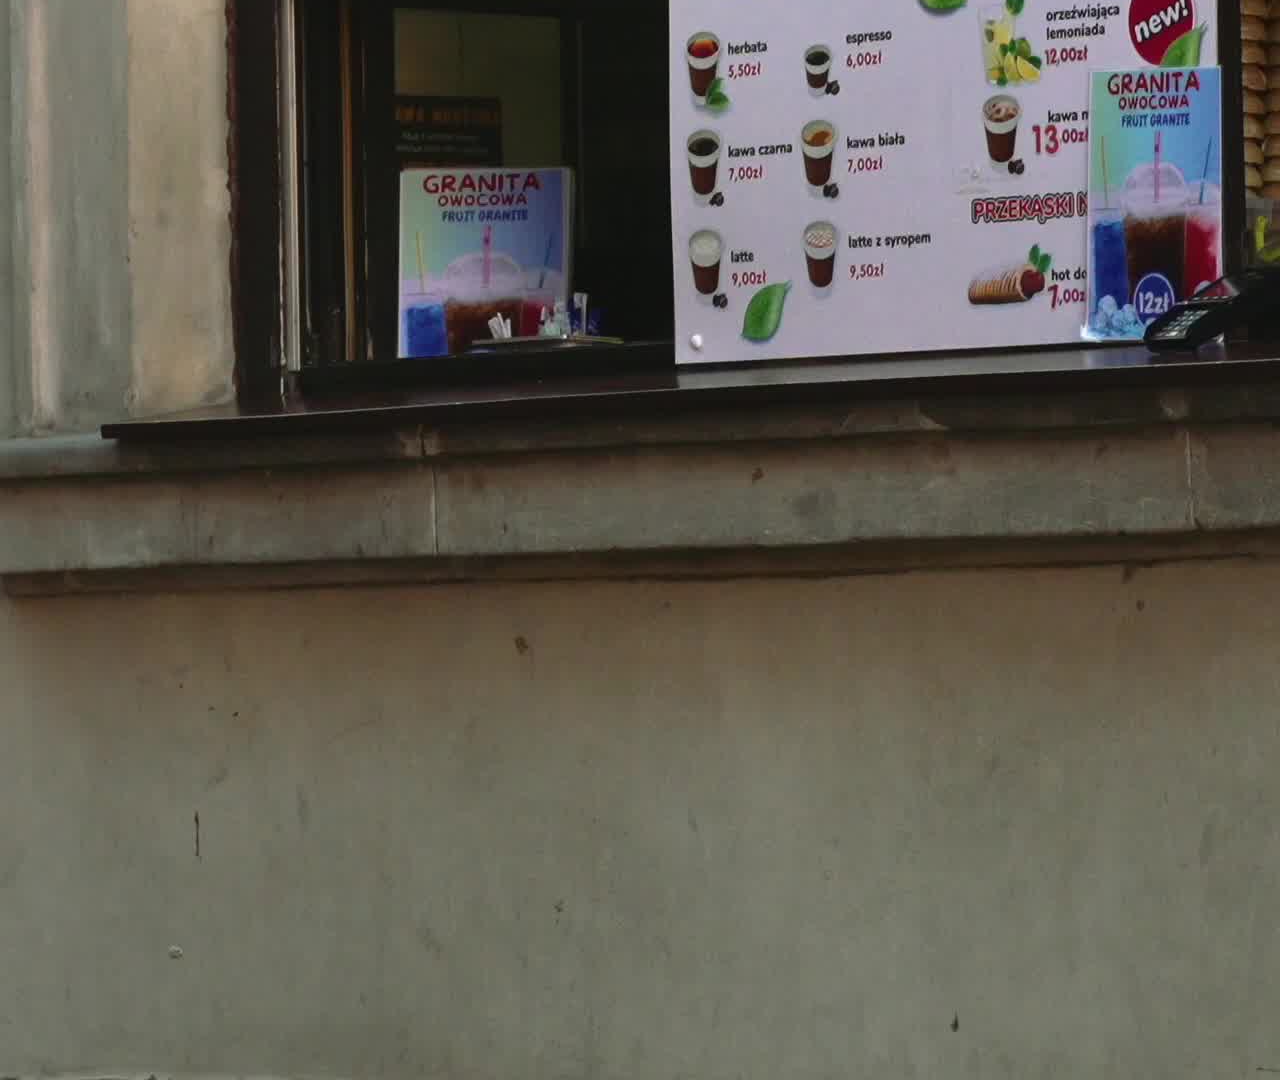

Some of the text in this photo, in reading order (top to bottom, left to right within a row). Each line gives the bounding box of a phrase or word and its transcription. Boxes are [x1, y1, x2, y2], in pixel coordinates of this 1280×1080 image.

[1046, 4, 1120, 21] orzeźwiająca
[846, 31, 892, 46] espresso
[1047, 23, 1105, 40] lemoniada
[728, 41, 767, 55] herbata
[1045, 45, 1088, 66] 12,00zł
[847, 51, 881, 68] 6,00zł
[729, 62, 760, 79] 5,50zł
[1108, 70, 1200, 95] GRANITA
[1119, 94, 1189, 110] OWOCOWA
[1048, 110, 1078, 123] kawa
[1122, 113, 1190, 128] FRUIT GRANITE
[847, 132, 905, 149] kawa biała
[728, 144, 792, 158] kawa czarna
[729, 165, 762, 182] 7,00zł
[848, 156, 882, 174] 7,00zł
[423, 172, 543, 195] GRANITA
[438, 192, 528, 208] OWOCOWA
[971, 192, 1074, 224] PRZEKĄSKI
[442, 210, 476, 222] FRUIT
[849, 234, 931, 248] latte syropem
[731, 251, 754, 263] latte
[732, 270, 766, 287] 9,00zł
[850, 263, 884, 280] 9,50zł
[1052, 269, 1070, 281] hot
[1138, 292, 1169, 314] 12zł
